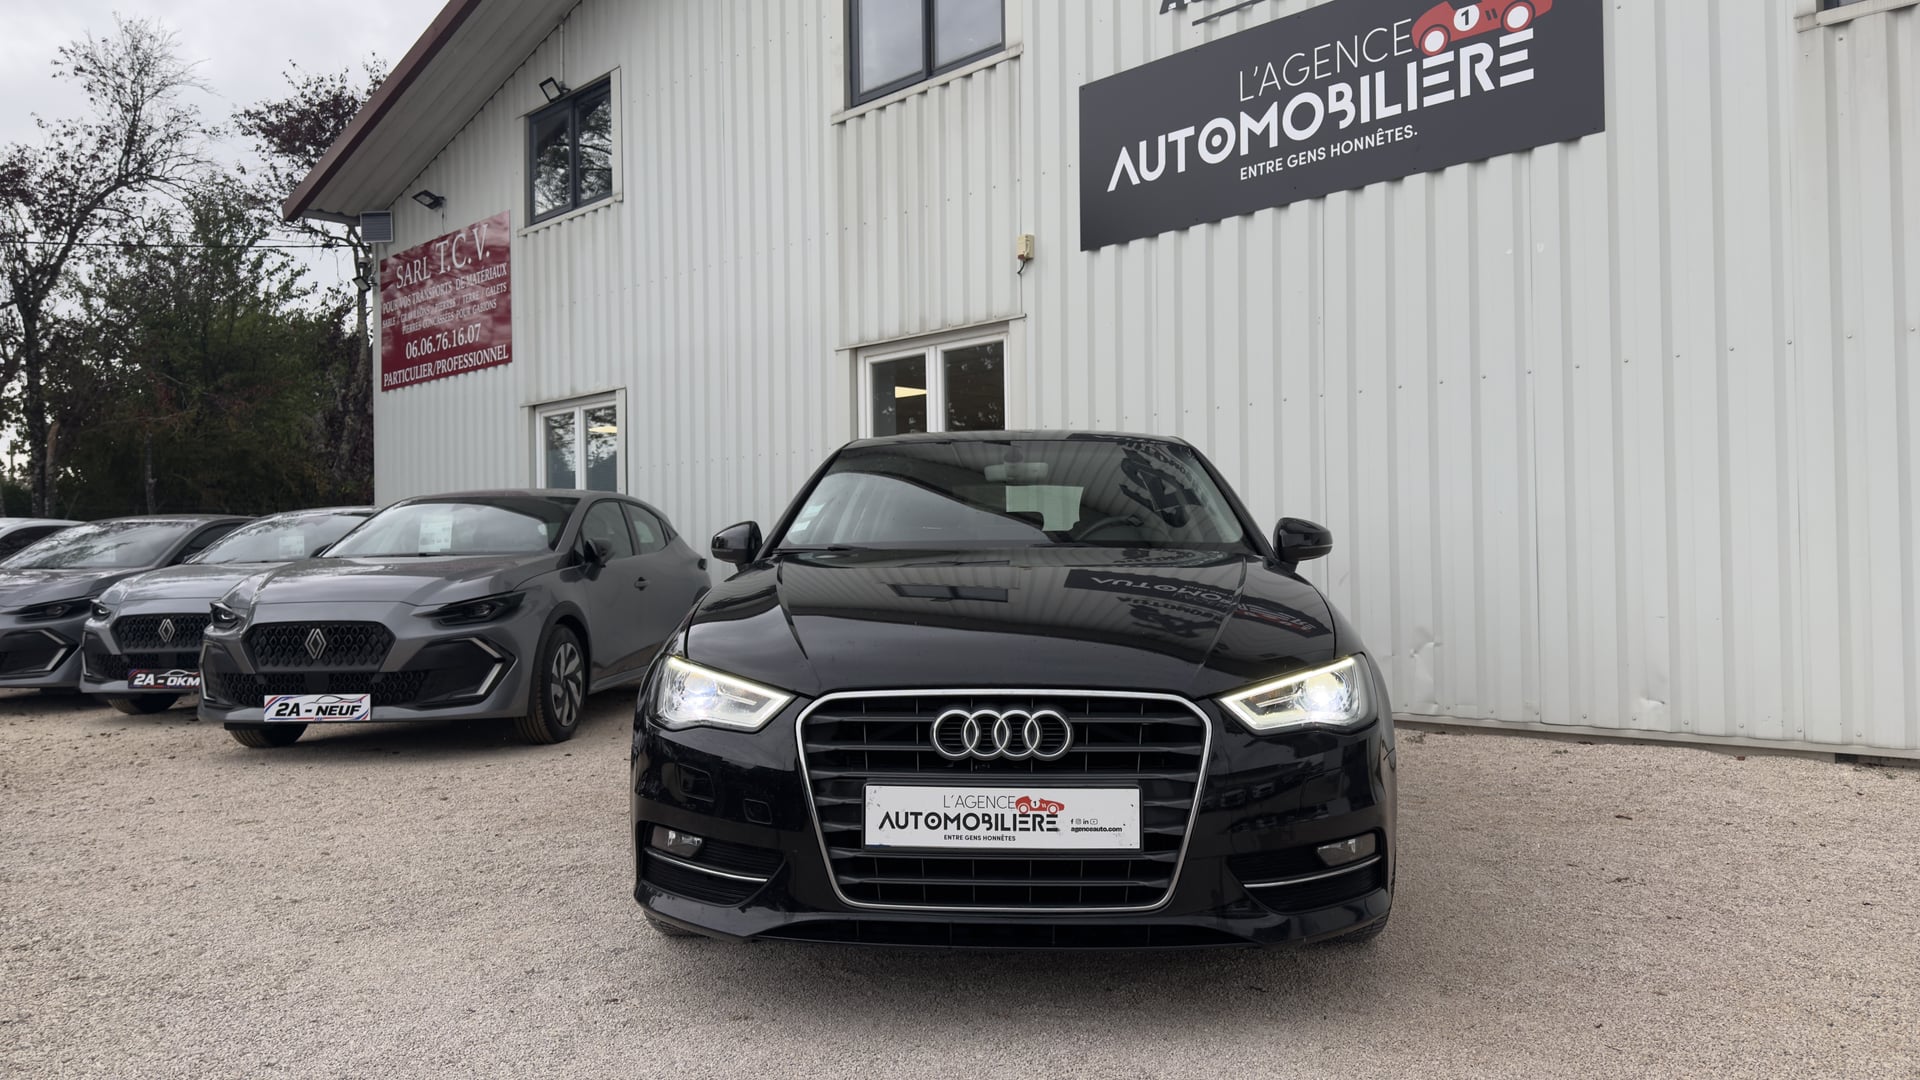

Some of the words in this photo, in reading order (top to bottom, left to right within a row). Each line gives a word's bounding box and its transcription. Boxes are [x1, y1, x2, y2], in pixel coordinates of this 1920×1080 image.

[1240, 157, 1284, 181] ENTRE
[1286, 146, 1327, 169] GENS
[1329, 124, 1419, 158] HONNÊTES.
[382, 300, 399, 315] POUR
[412, 281, 453, 304] TRANSPORTS
[455, 276, 466, 291] DE
[466, 262, 508, 286] MATÉRIAUX
[396, 256, 432, 289] SARL
[485, 281, 507, 297] GALETS
[405, 323, 481, 360] 06.06.76.16.07
[383, 344, 509, 387] PARTICULIER/PROFESSIONNEL
[133, 673, 155, 686] 2A
[275, 702, 301, 717] 2A
[315, 704, 362, 716] NEUF
[982, 833, 1016, 841] HONNÊTES
